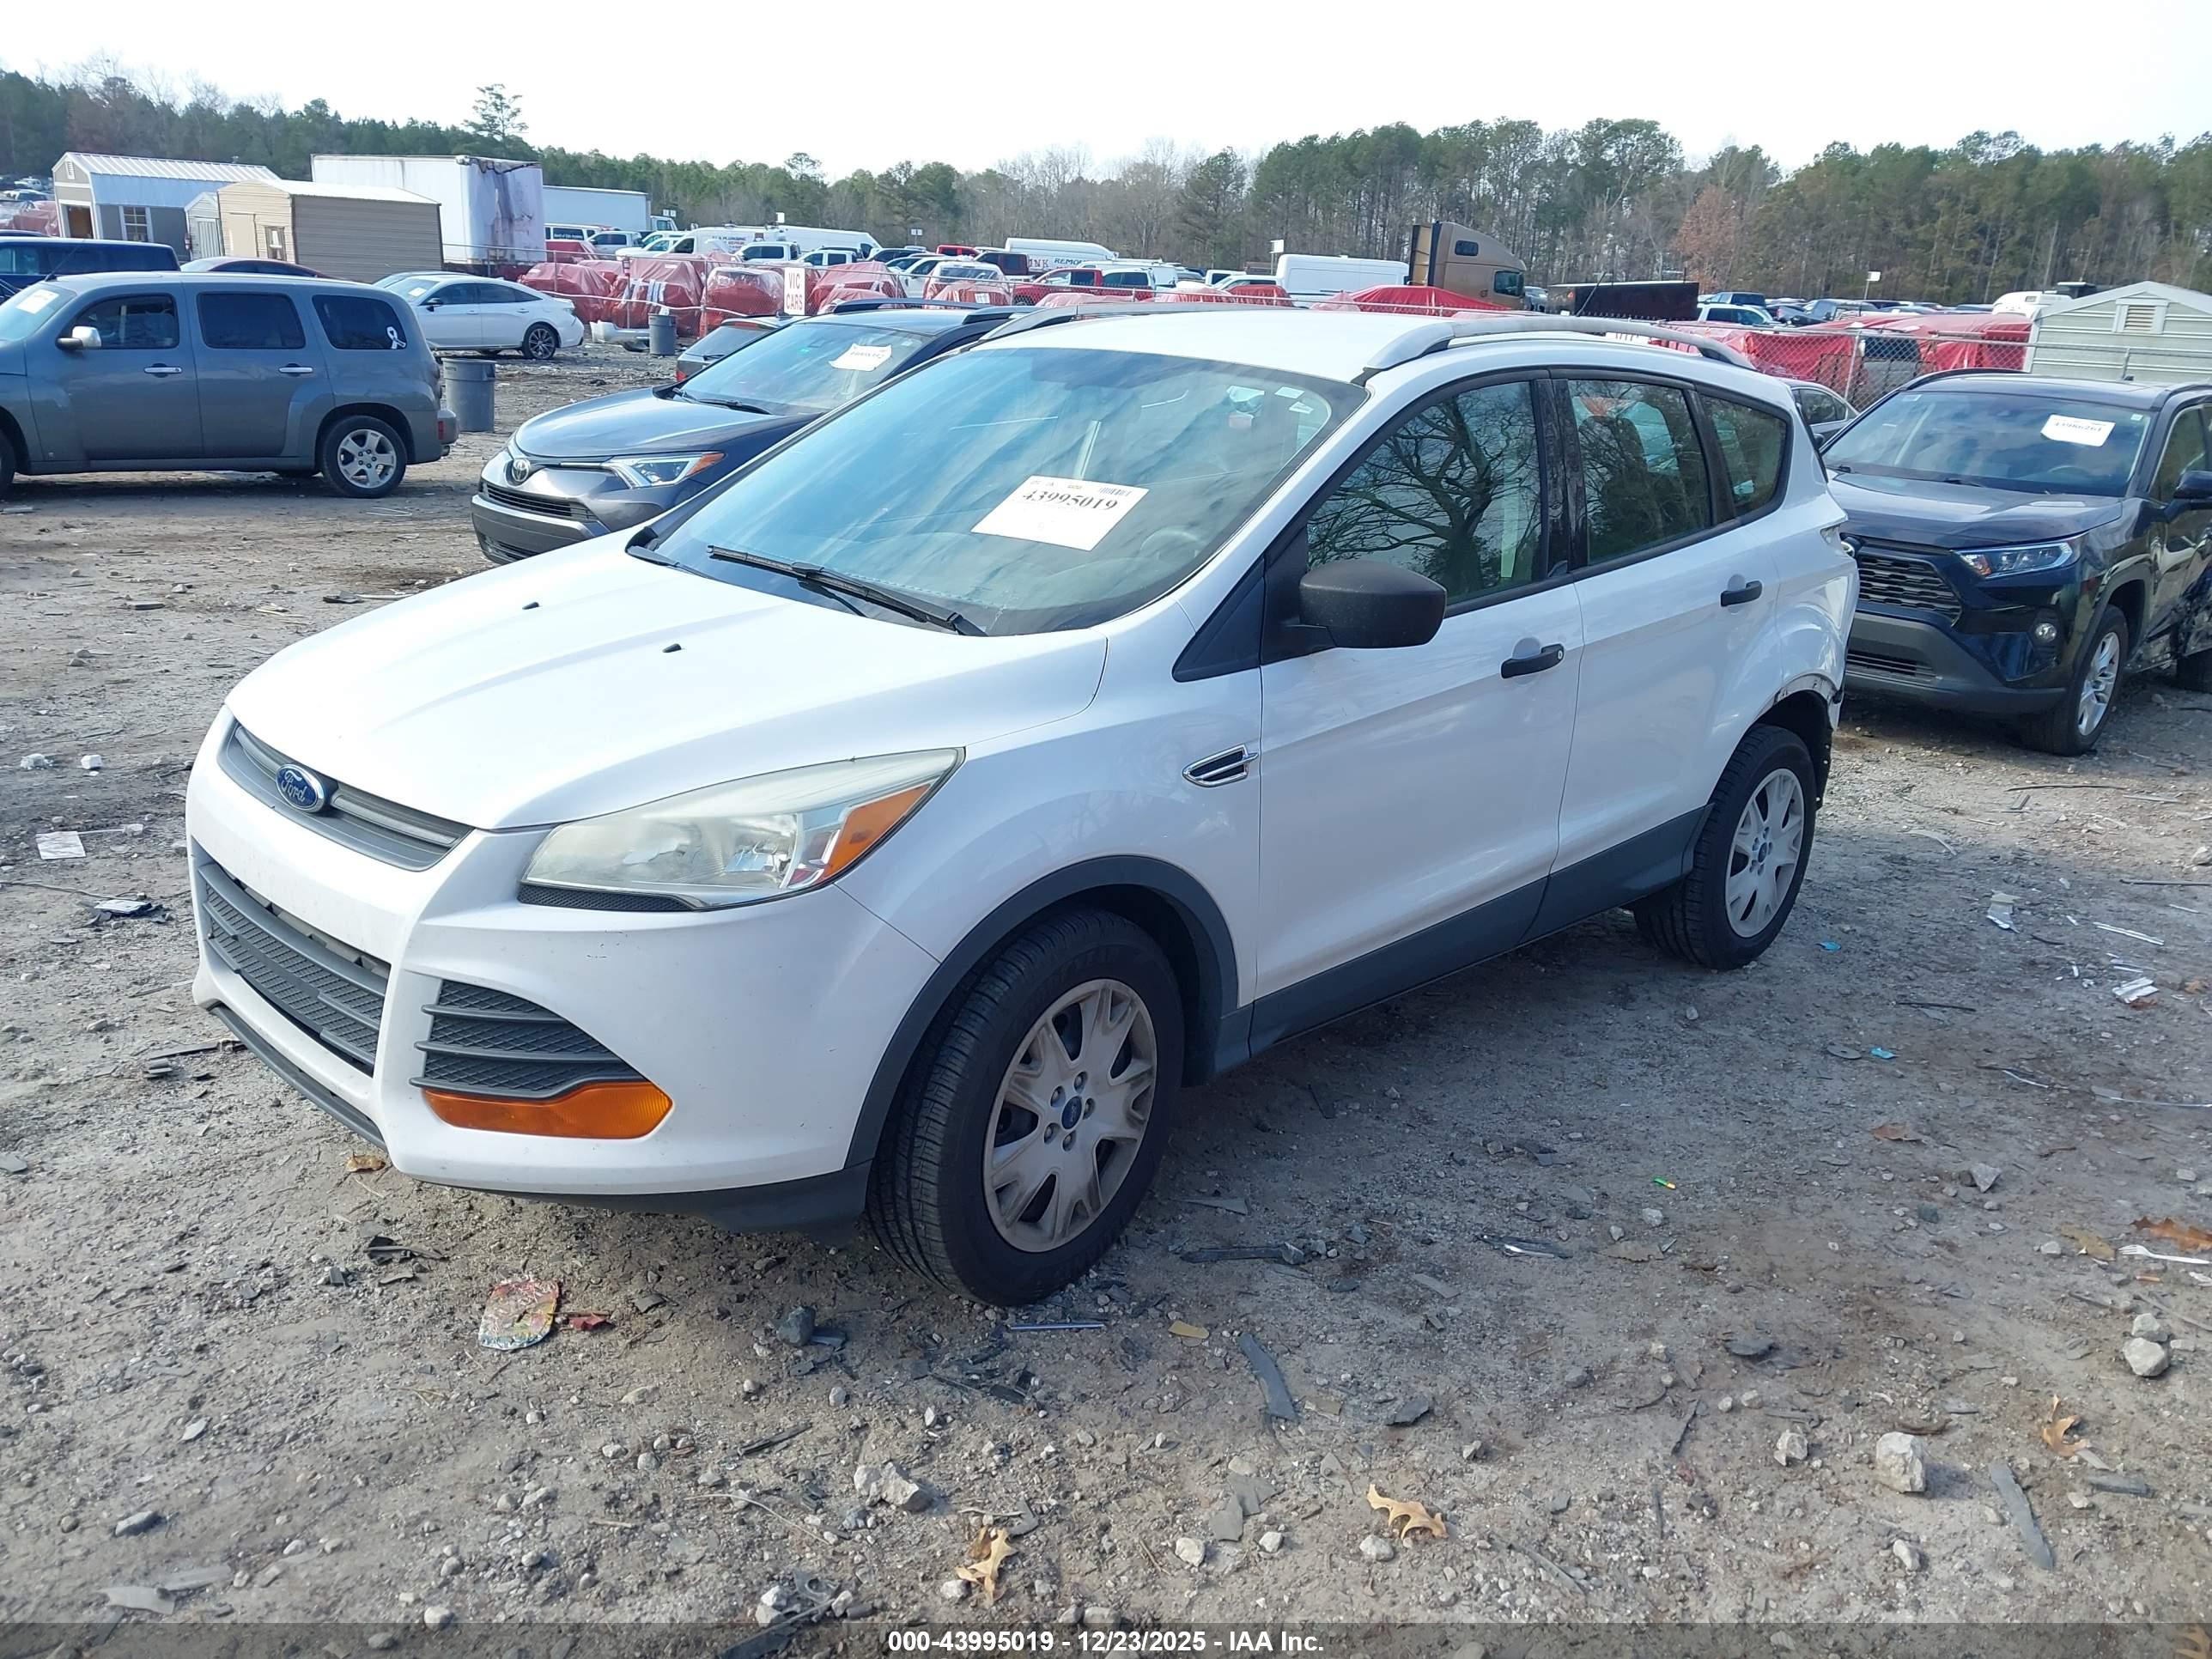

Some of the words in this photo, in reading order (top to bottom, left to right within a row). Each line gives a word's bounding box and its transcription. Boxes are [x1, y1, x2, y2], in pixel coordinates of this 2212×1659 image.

[788, 272, 801, 289] VIC
[787, 293, 803, 310] CARS
[1023, 489, 1119, 510] 43995019
[281, 769, 307, 802] Ford
